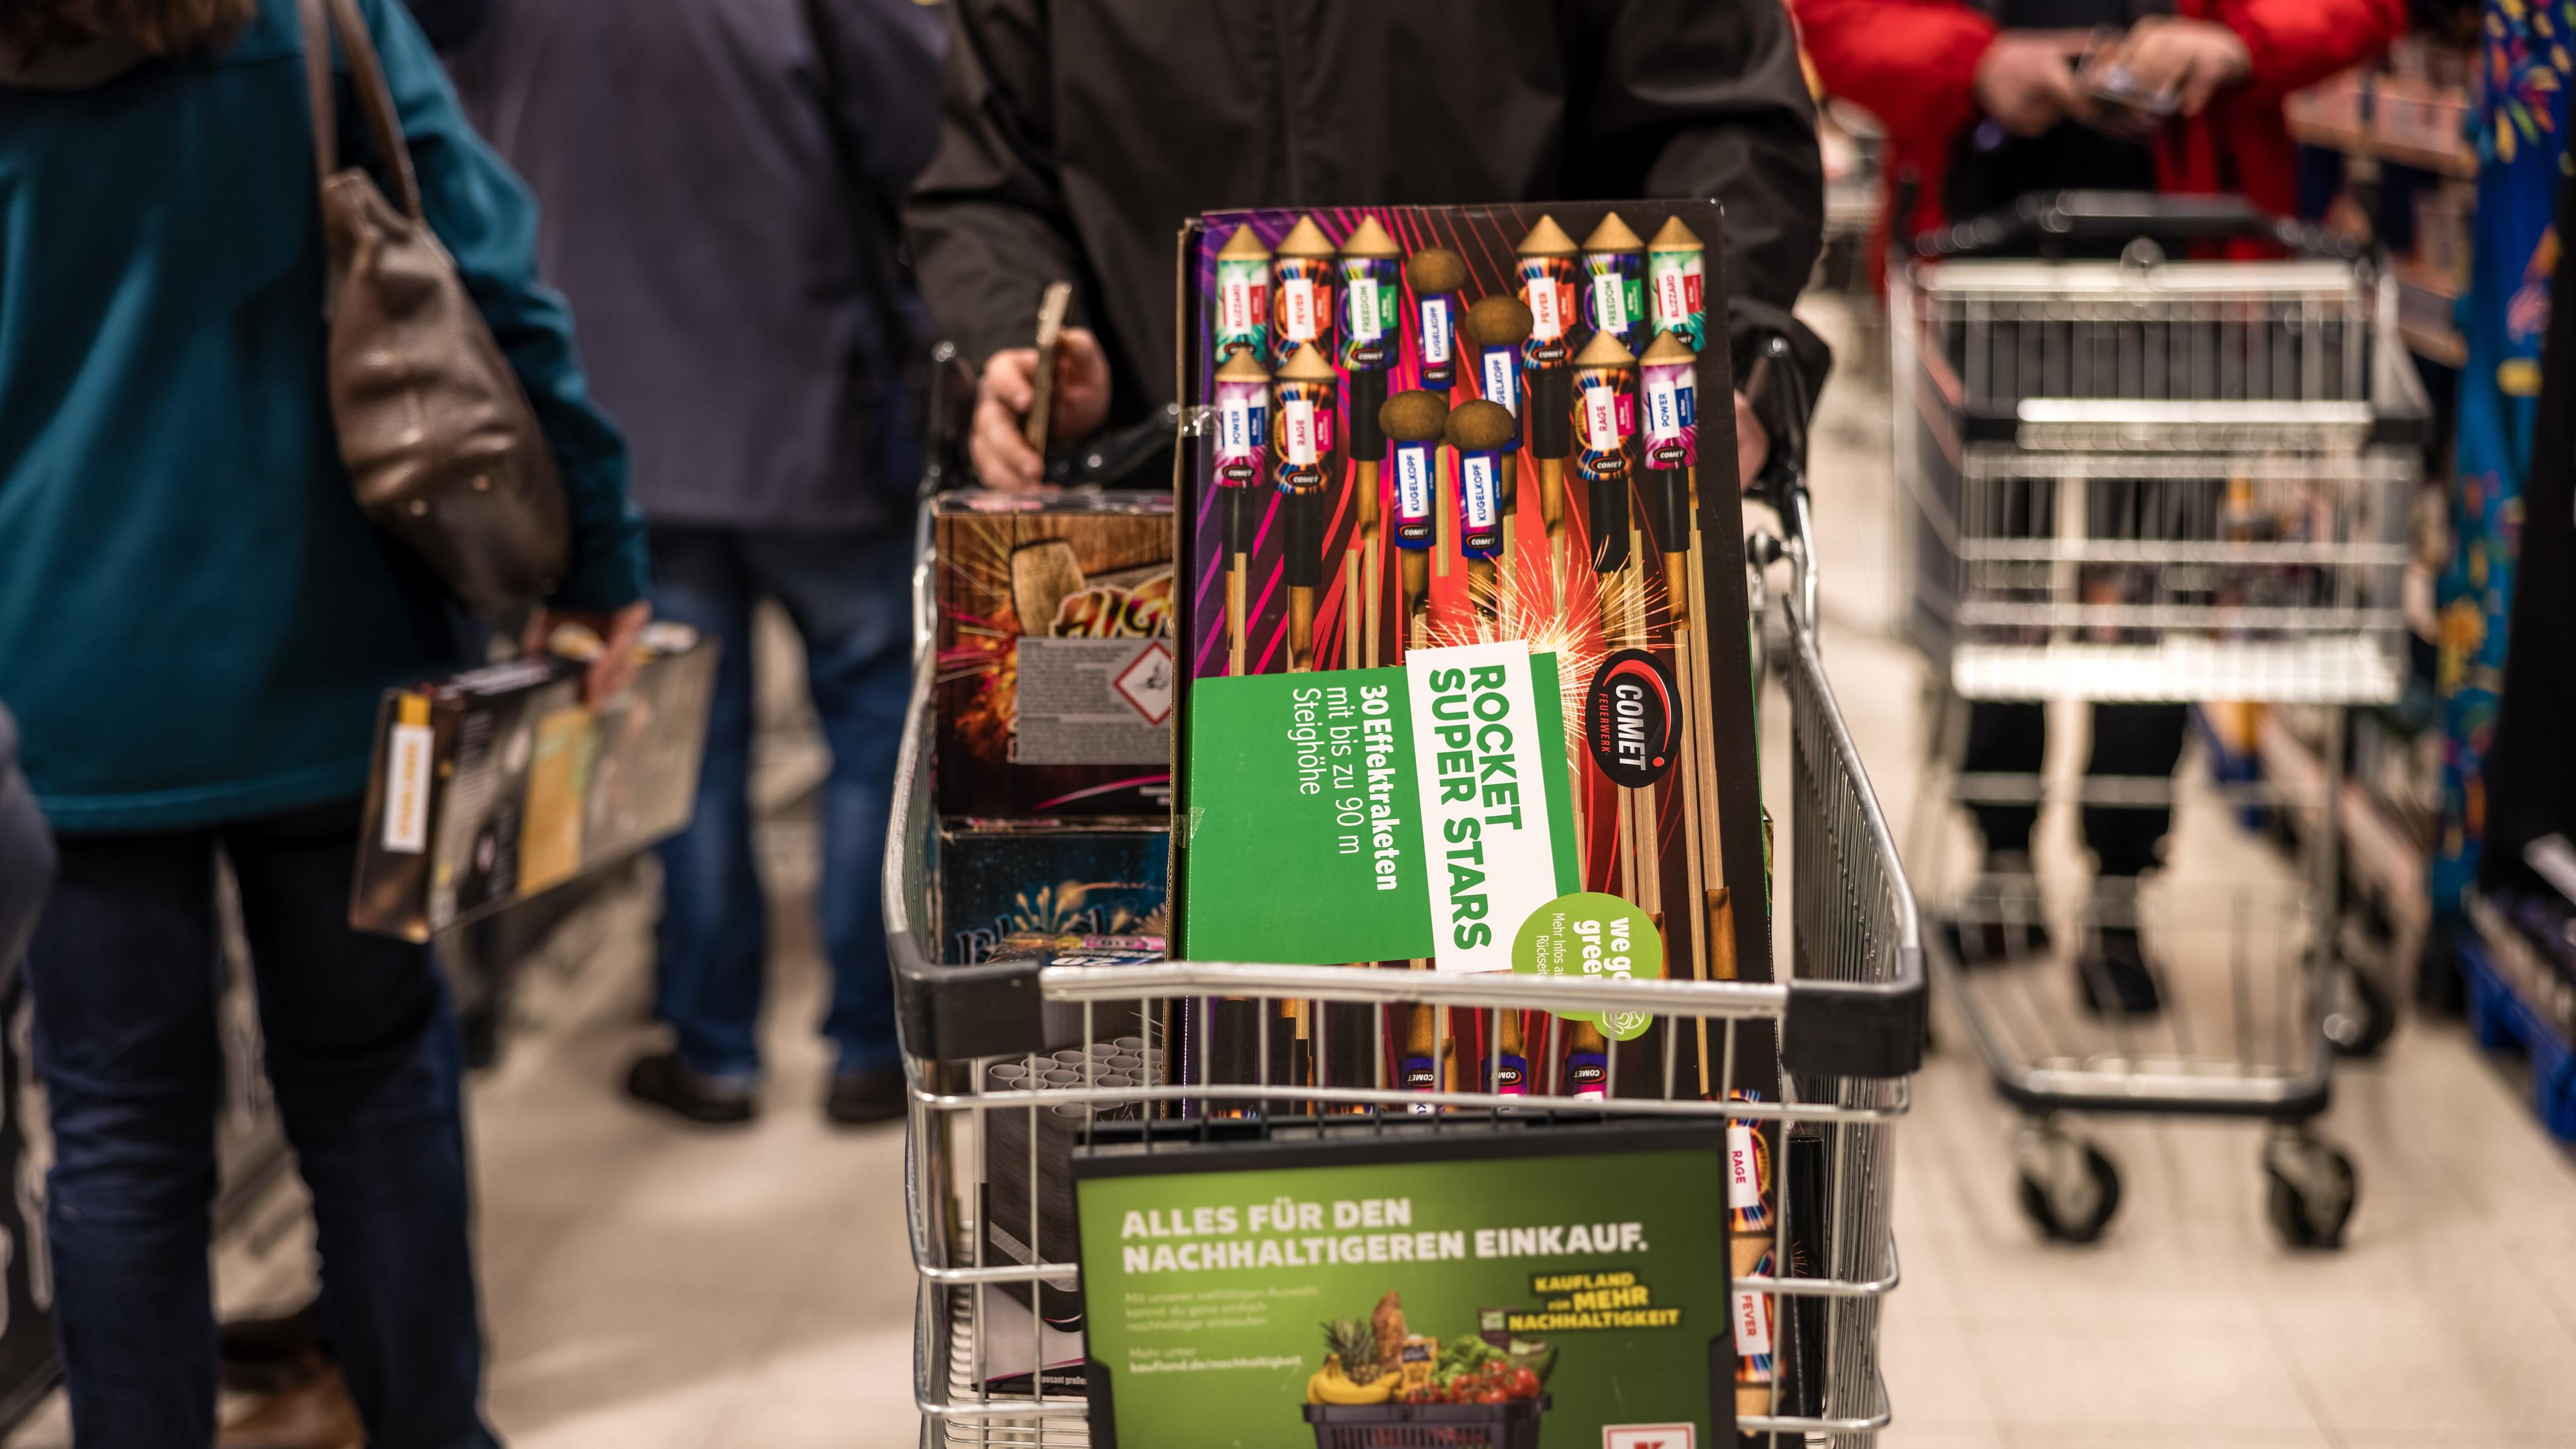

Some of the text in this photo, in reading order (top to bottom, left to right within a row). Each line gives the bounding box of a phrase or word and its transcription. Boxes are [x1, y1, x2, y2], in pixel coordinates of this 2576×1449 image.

[1295, 293, 1305, 325] FEVER
[1360, 286, 1371, 334] FREEDOM
[1538, 292, 1550, 324] FEVER
[1605, 280, 1615, 327] FREEDOM
[1666, 274, 1679, 318] BLIZZARD
[1429, 307, 1442, 357] KUGELKOPF
[1538, 350, 1563, 359] COMET
[1597, 405, 1608, 432] RAGE
[1658, 393, 1670, 427] POWER
[1232, 411, 1240, 445] POWER
[1295, 419, 1305, 446] RAGE
[1597, 461, 1622, 470] COMET
[1660, 451, 1684, 460] COMET
[1228, 470, 1252, 478] COMET
[1293, 475, 1319, 484] COMET
[1406, 455, 1420, 512] KUGELKOPF
[1472, 464, 1487, 521] KUGELKOPF
[1404, 528, 1429, 536] COMET
[1471, 537, 1496, 546] COMET
[1599, 693, 1611, 753] FEUERWERK
[1615, 684, 1646, 771] COMET
[1287, 688, 1327, 795] Steighöhe
[1470, 665, 1523, 830] ROCKET
[1327, 687, 1364, 854] mit bis zu 90 m
[1360, 686, 1400, 891] 30 Effektraketen
[1429, 669, 1492, 949] SUPER STARS
[1552, 913, 1565, 937] Mehr
[1610, 917, 1630, 952] we
[1554, 941, 1566, 964] Infos
[1573, 920, 1602, 981] gree
[1407, 1074, 1434, 1082] COMET
[1574, 1069, 1600, 1079] COMET
[1732, 1149, 1746, 1185] RAGE
[1121, 1195, 1412, 1240] ALLES FÜR DEN
[1122, 1222, 1649, 1274] NACHHALTIGEREN EINKAUF.
[1534, 1272, 1635, 1293] KAUFLAND
[1572, 1285, 1649, 1311] MEHR
[1508, 1308, 1680, 1331] NACHHALTIGKEIT
[1741, 1294, 1756, 1338] FEVER
